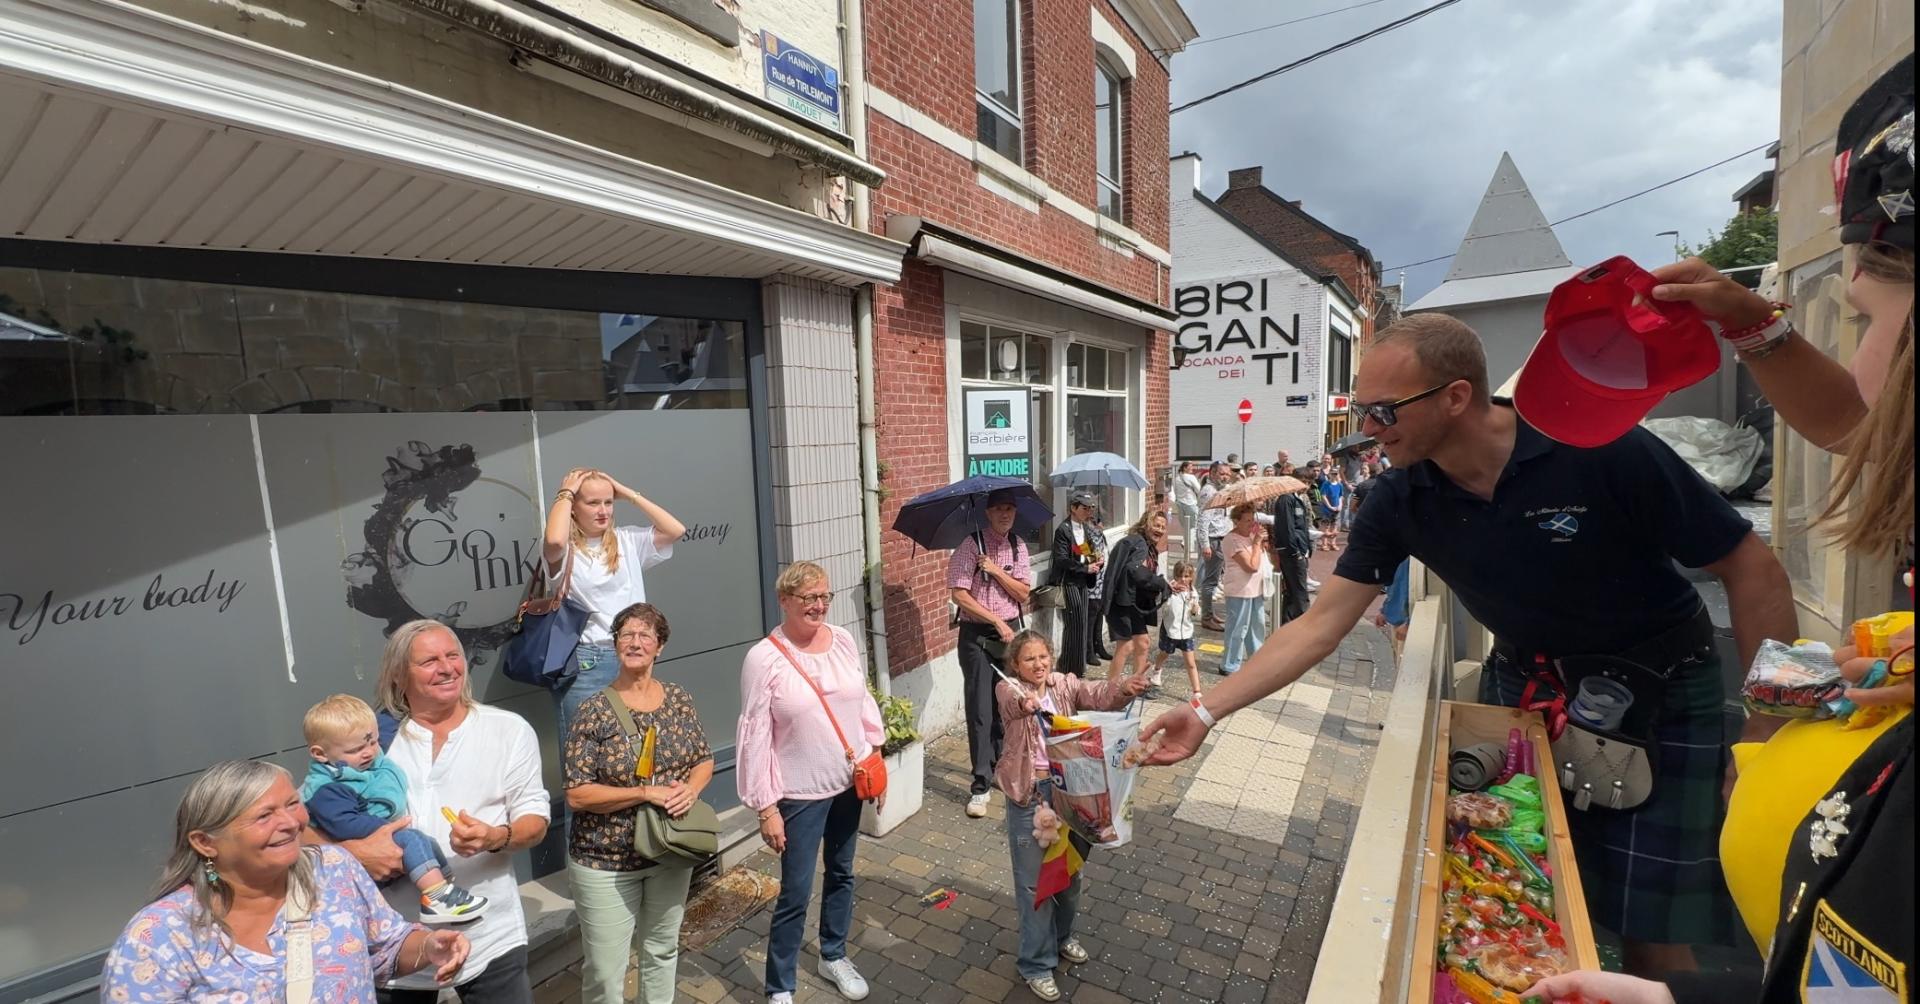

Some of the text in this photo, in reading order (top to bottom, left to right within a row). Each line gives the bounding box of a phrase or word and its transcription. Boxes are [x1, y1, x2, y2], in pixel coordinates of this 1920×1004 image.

[788, 52, 818, 76] HANNUT
[772, 66, 833, 107] Rue de TIRLEMONT
[787, 97, 822, 121] MAQUET
[1175, 278, 1268, 317] BRI
[1175, 313, 1300, 354] GAN
[1176, 355, 1246, 369] OCANDA
[1218, 369, 1245, 379] DEI
[1251, 351, 1299, 385] TI
[969, 433, 1026, 444] Barbière
[969, 457, 1028, 477] À VENDRE
[682, 523, 732, 545] story
[0, 569, 247, 646] Your body
[1819, 913, 1896, 988] SCOTLAND
